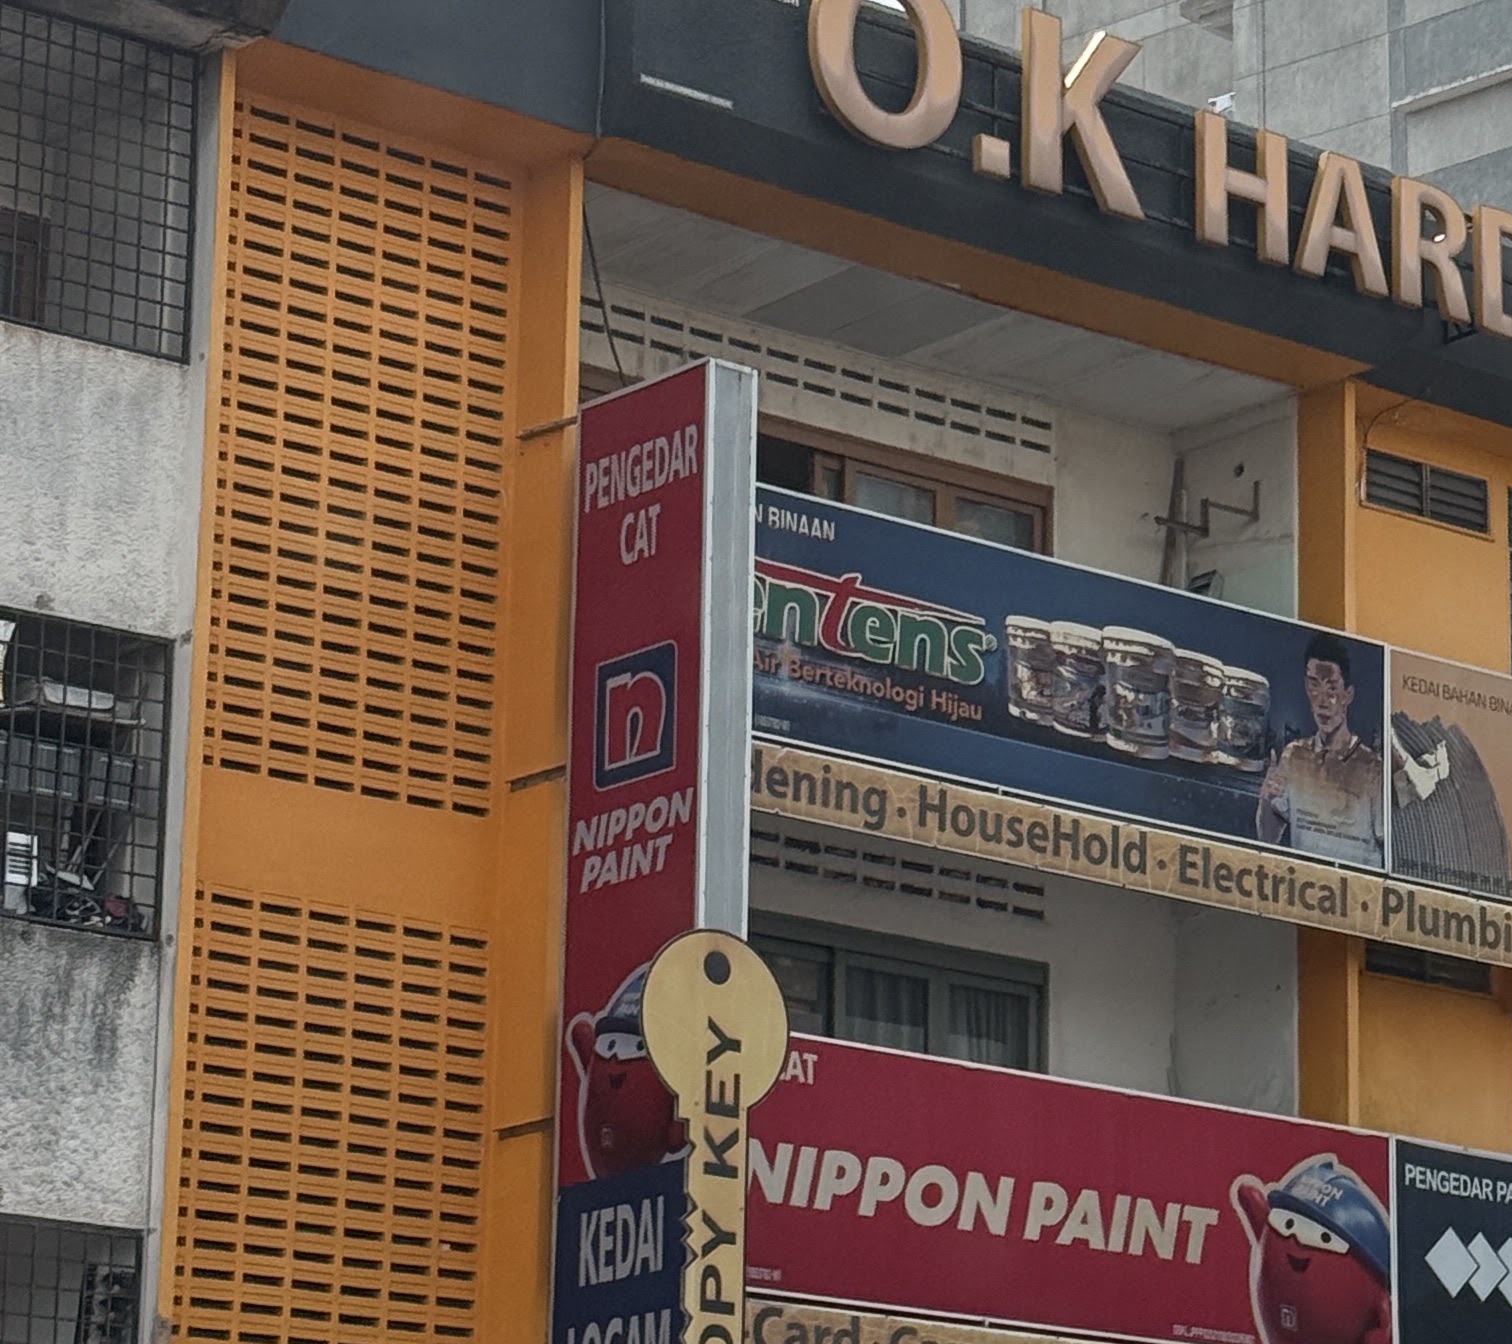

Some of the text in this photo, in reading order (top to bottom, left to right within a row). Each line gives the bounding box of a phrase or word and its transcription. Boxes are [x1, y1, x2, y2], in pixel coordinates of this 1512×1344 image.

[583, 424, 699, 514] PENGEDAR
[619, 505, 661, 566] CAT
[767, 506, 836, 543] BINAAN
[787, 658, 925, 711] Berteknologi
[930, 688, 983, 721] Hijau
[1402, 675, 1440, 698] KEDAI
[1442, 684, 1488, 710] BAHAN
[573, 787, 696, 856] NIPPON
[752, 748, 888, 829] ening
[917, 783, 1148, 876] HouseHold
[1178, 843, 1349, 919] Electrical
[580, 834, 672, 894] PAINT
[702, 1015, 743, 1180] KEY
[779, 1050, 819, 1086] AT
[748, 1137, 1220, 1264] NIPPON PAINT
[1404, 1163, 1494, 1203] PENGEDAR
[578, 1194, 666, 1288] KEDAI
